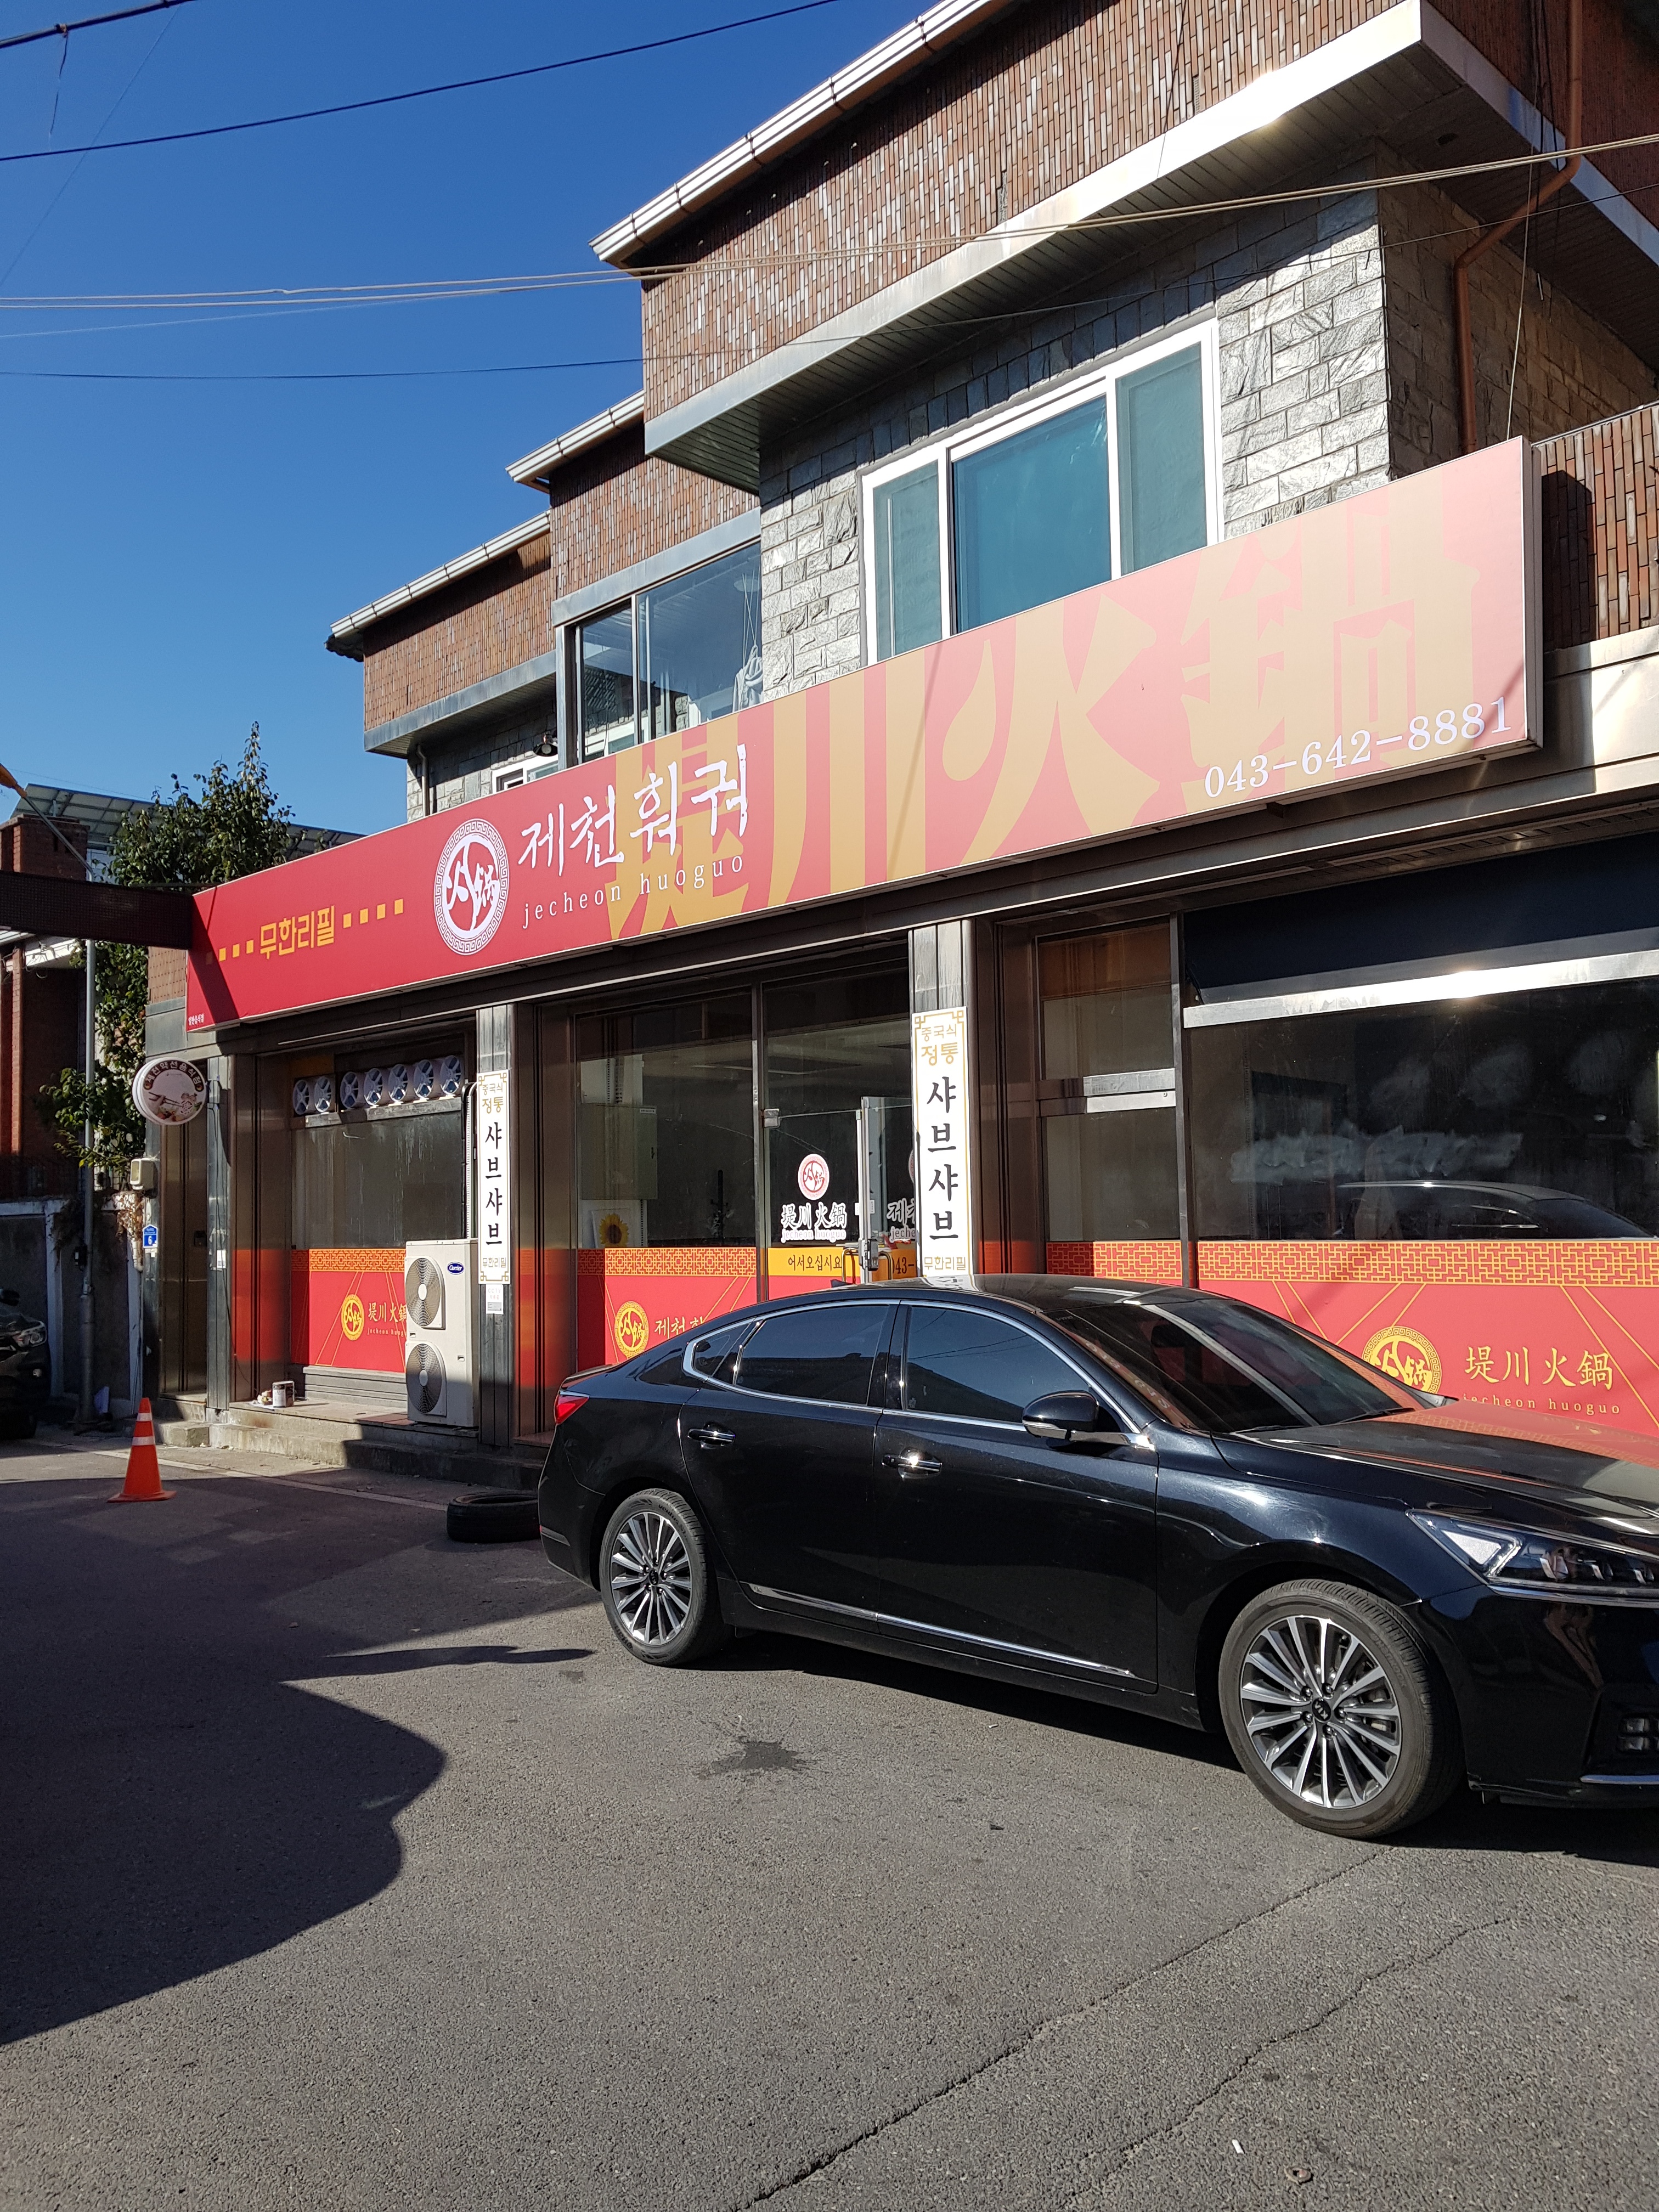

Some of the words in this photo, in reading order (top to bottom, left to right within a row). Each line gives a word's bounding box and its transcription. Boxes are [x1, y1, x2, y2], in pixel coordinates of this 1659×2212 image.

[1204, 697, 1511, 798] 043-642-8881
[523, 884, 622, 929] jecheon
[640, 855, 743, 895] huoguo
[259, 905, 335, 960] 무한리필
[921, 1023, 957, 1042] 중국식
[921, 1042, 958, 1066] 정통
[482, 1082, 503, 1096] 중국식
[482, 1096, 504, 1114] 정통
[926, 1076, 959, 1240] 샤브샤브
[484, 1121, 503, 1245] 샤브샤브
[781, 1201, 847, 1229] 堤川火鍋
[148, 1235, 152, 1245] 6
[782, 1228, 814, 1242] jecheon
[815, 1228, 846, 1242] huoguo
[482, 1257, 506, 1268] 무한리필
[893, 1256, 915, 1274] 43-
[924, 1256, 966, 1270] 무한리필
[1464, 1345, 1613, 1390] 堤川火鍋
[1549, 1397, 1621, 1415] huoguo
